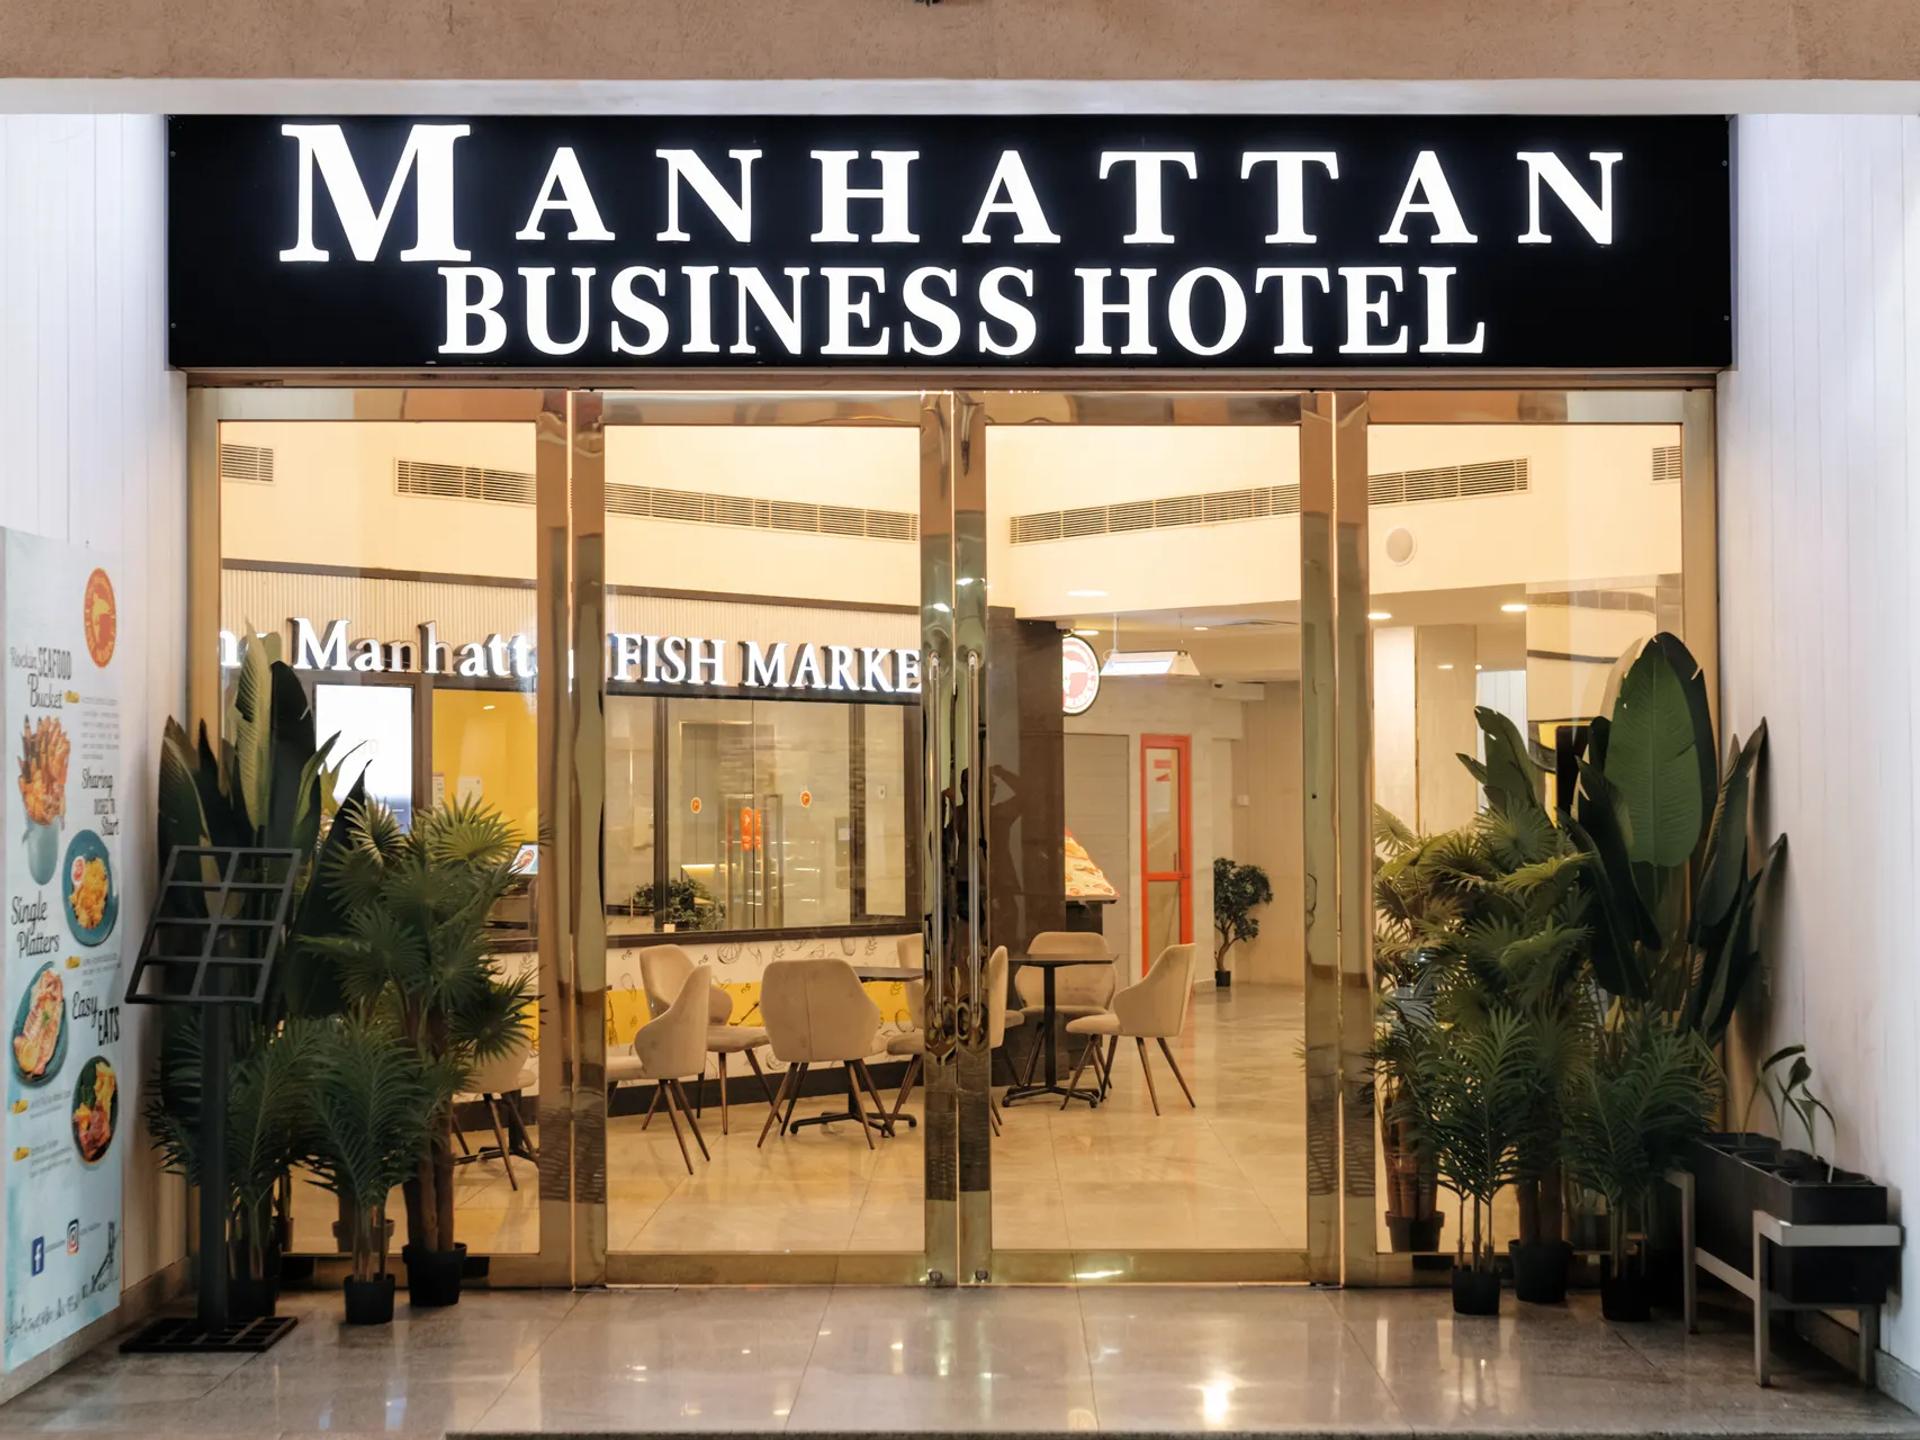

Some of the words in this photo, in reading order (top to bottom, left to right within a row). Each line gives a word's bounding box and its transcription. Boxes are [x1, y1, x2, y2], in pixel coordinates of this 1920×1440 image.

[278, 123, 1624, 263] MANHATTAN
[437, 264, 1039, 357] BUSINESS
[1073, 265, 1487, 357] HOTEL
[38, 646, 72, 680] SEAFOOD
[288, 616, 539, 678] Manhatt
[608, 632, 728, 686] FISH
[739, 640, 922, 693] MARKE
[27, 672, 63, 709] Bucket
[11, 890, 48, 935] Single
[17, 926, 60, 958] Platters
[72, 991, 98, 1029] Easy
[98, 1006, 120, 1047] EATS
